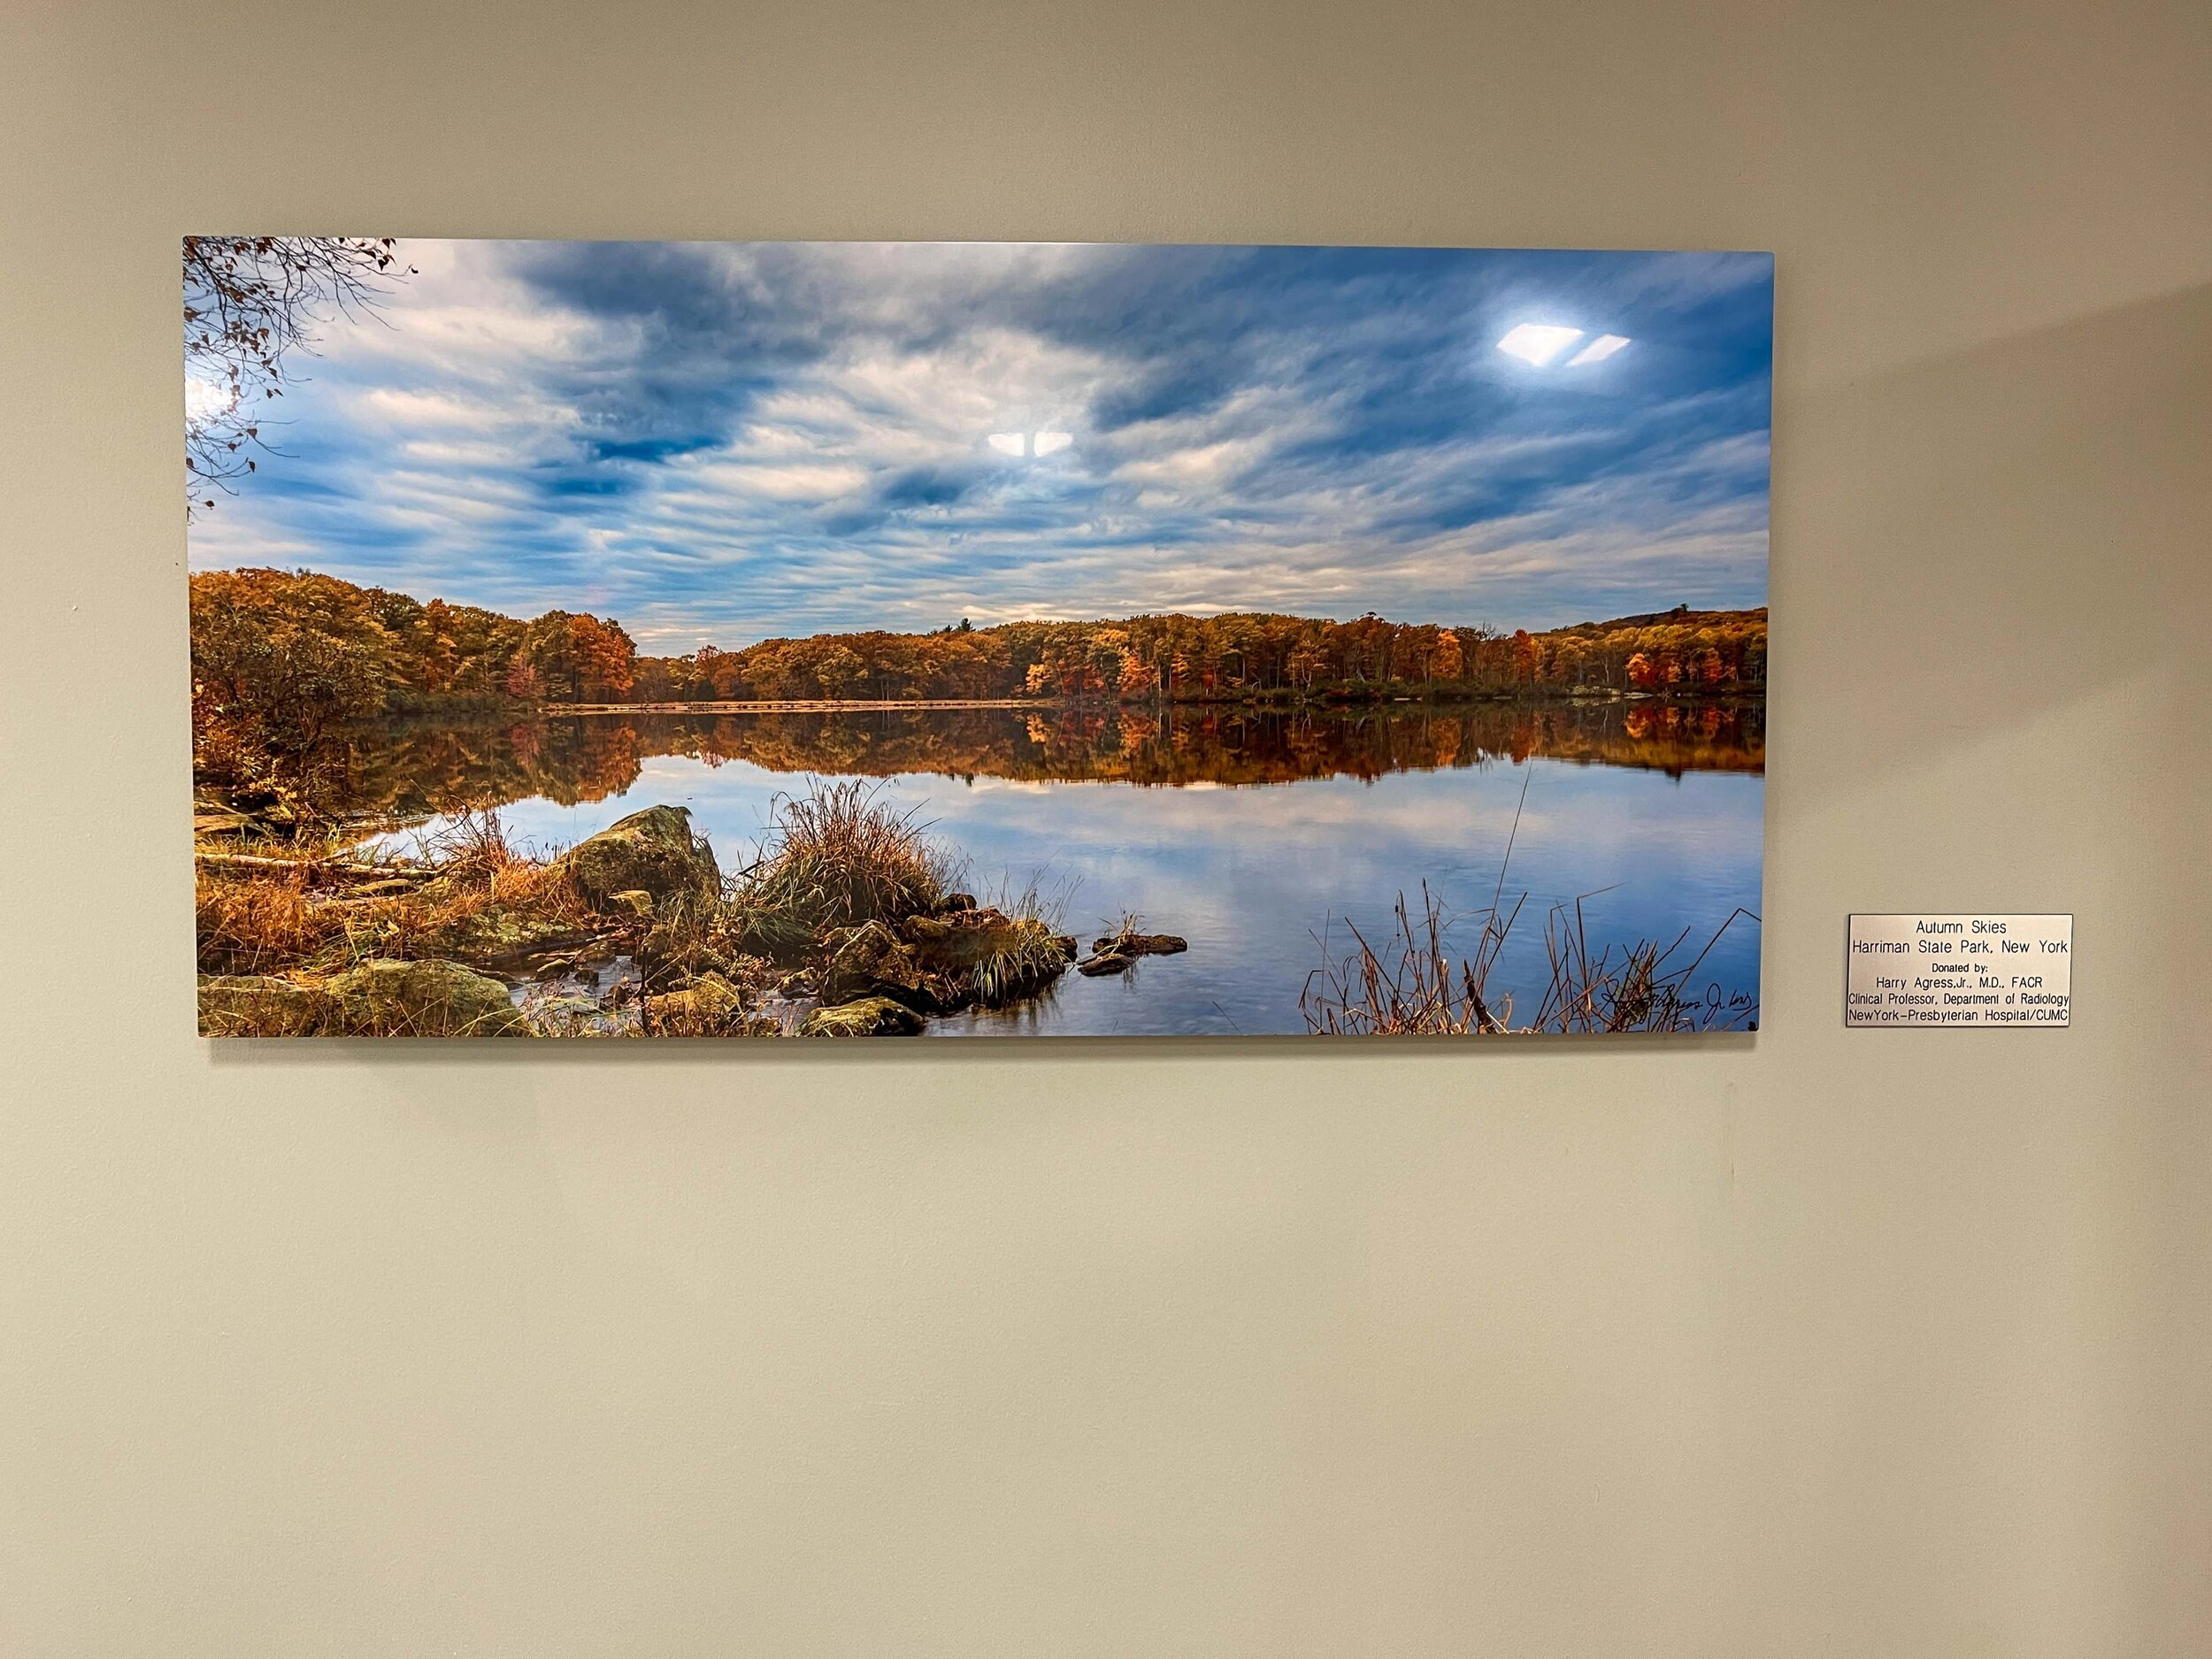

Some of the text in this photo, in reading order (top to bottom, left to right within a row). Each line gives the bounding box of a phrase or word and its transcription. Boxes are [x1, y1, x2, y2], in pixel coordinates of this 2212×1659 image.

[1916, 920, 2007, 933] Autumn Skies
[1853, 941, 1909, 953] Harriman
[1919, 941, 1952, 953] State
[2002, 941, 2030, 953] New
[2039, 941, 2068, 953] York
[1932, 964, 1988, 973] Donated by:
[1877, 977, 1906, 990] Harry
[2012, 977, 2042, 987] FACR
[1849, 994, 1882, 1004] Clinical
[1944, 994, 1999, 1006] Department
[2006, 994, 2014, 1004] of
[2021, 994, 2069, 1006] Radiology
[1985, 1010, 2068, 1023] Hospital/CUMC
